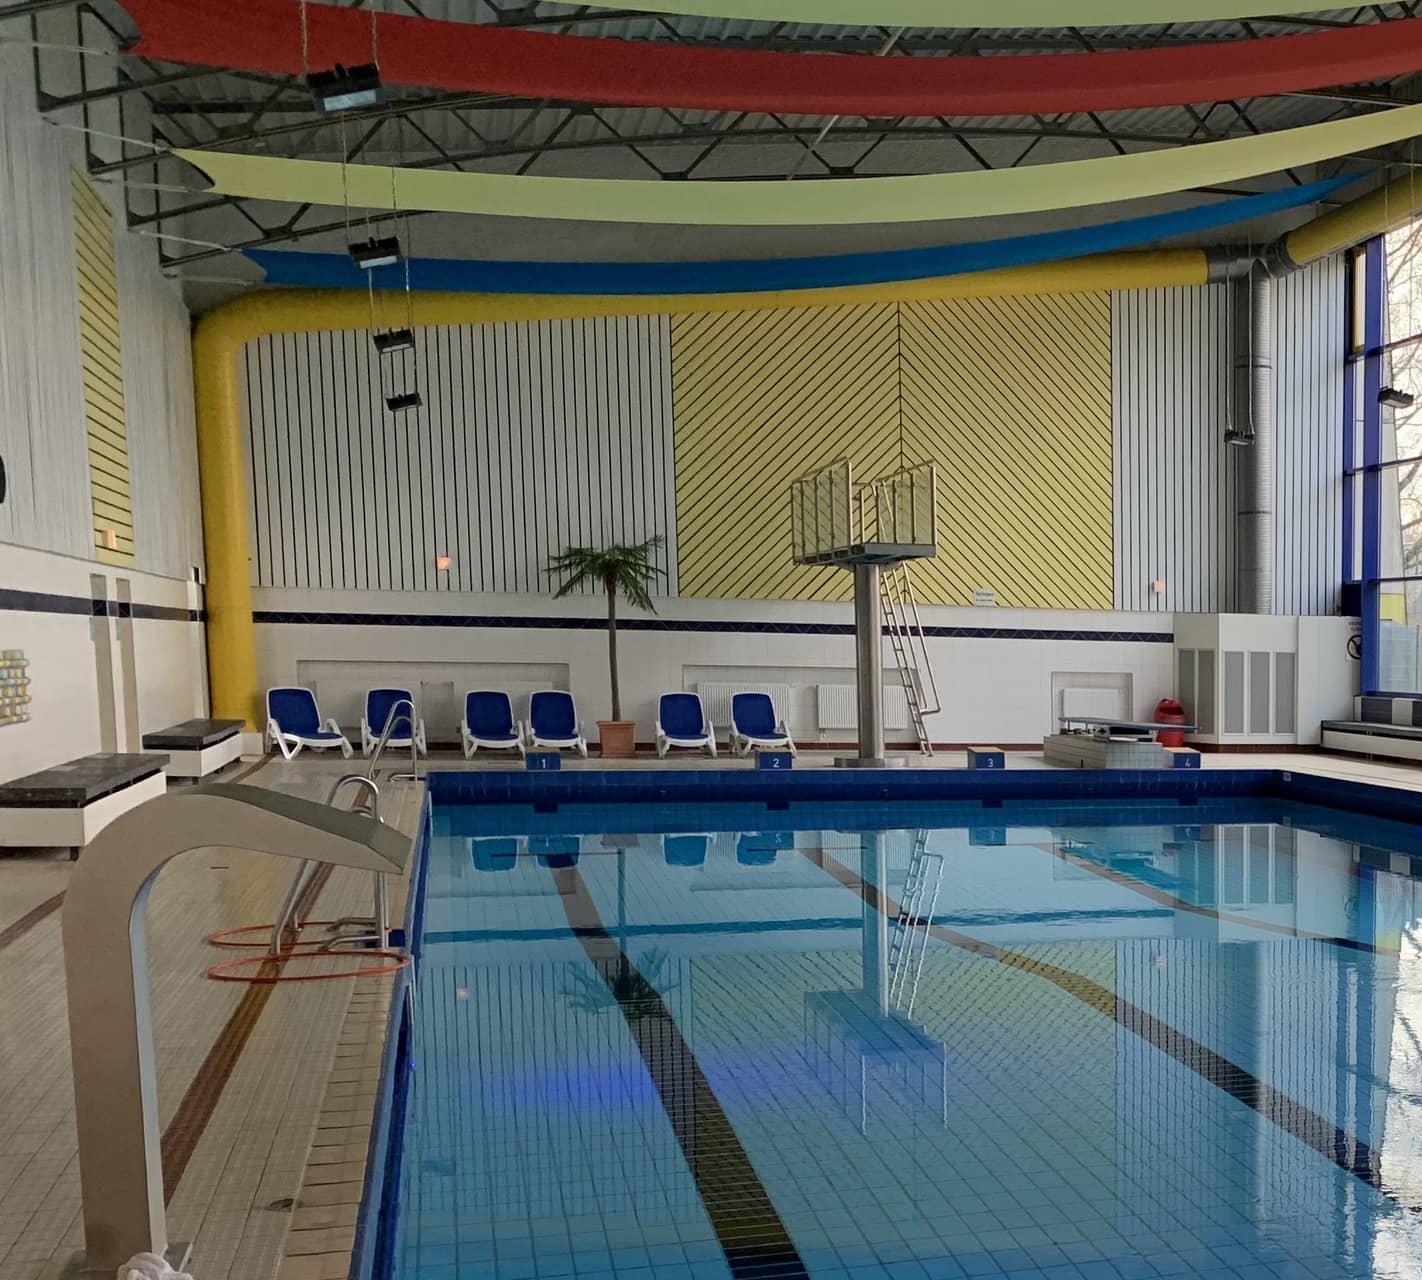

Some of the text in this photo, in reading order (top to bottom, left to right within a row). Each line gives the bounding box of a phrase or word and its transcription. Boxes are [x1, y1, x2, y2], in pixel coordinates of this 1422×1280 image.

[772, 758, 780, 768] 2
[987, 758, 994, 768] 3
[1184, 758, 1191, 768] 4
